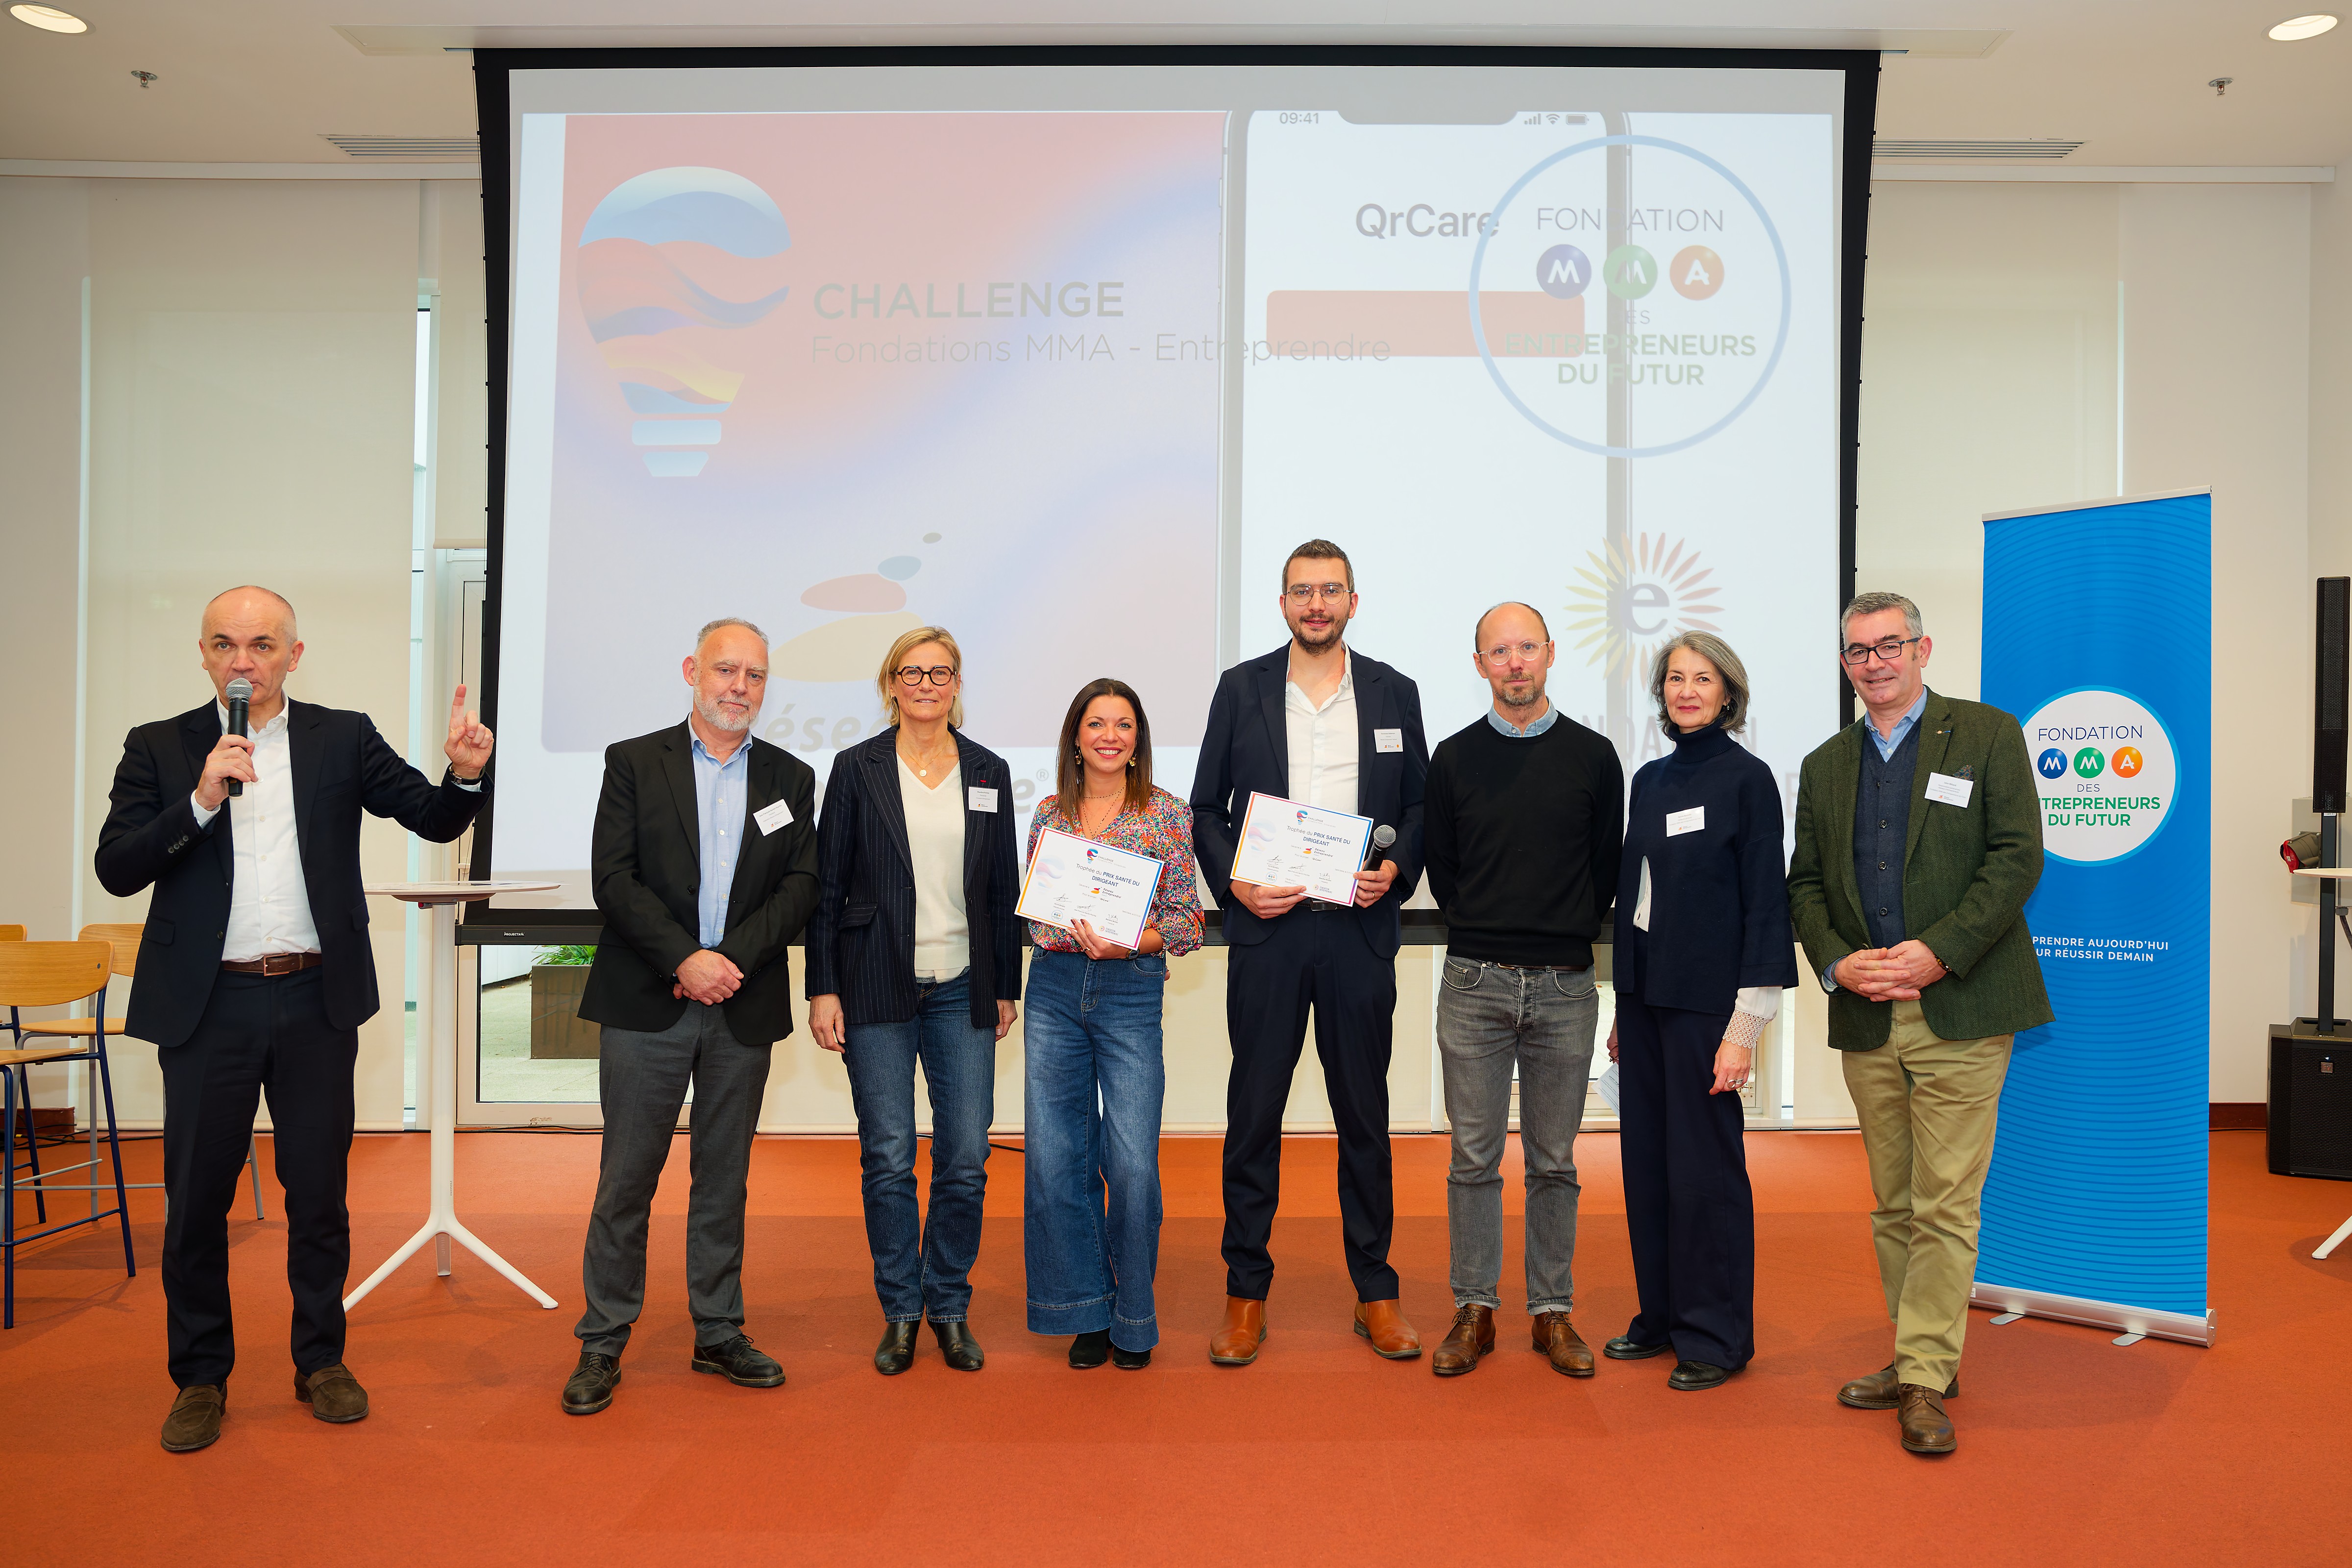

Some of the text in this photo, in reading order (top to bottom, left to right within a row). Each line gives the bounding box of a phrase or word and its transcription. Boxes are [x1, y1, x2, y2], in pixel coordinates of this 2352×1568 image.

[1279, 112, 1319, 124] 09:41
[1356, 203, 1499, 239] QrCare
[813, 281, 1124, 319] CHALLENGE
[812, 335, 1011, 364] Fondations
[1026, 334, 1115, 361] MMA
[1157, 333, 1391, 366] Entrprendre
[1506, 334, 1756, 356] ENTREPRENEURS
[1558, 363, 1704, 385] DU FUTUR
[2038, 725, 2143, 741] FONDATION
[2077, 784, 2100, 792] DES
[2039, 797, 2160, 809] TREPRENEURS
[2048, 813, 2131, 826] DU FUTUR
[1287, 825, 1306, 834] Trophée
[1303, 836, 1330, 846] DIRIGEANT
[1076, 863, 1095, 873] Trophée
[1115, 875, 1132, 884] SANTÉ
[1092, 876, 1119, 887] DIRIGEANT
[2033, 936, 2169, 951] PRENDRE AUJOURD'HUI
[2055, 948, 2104, 959] RÉUSSIR
[2108, 952, 2154, 962] DEMAIN
